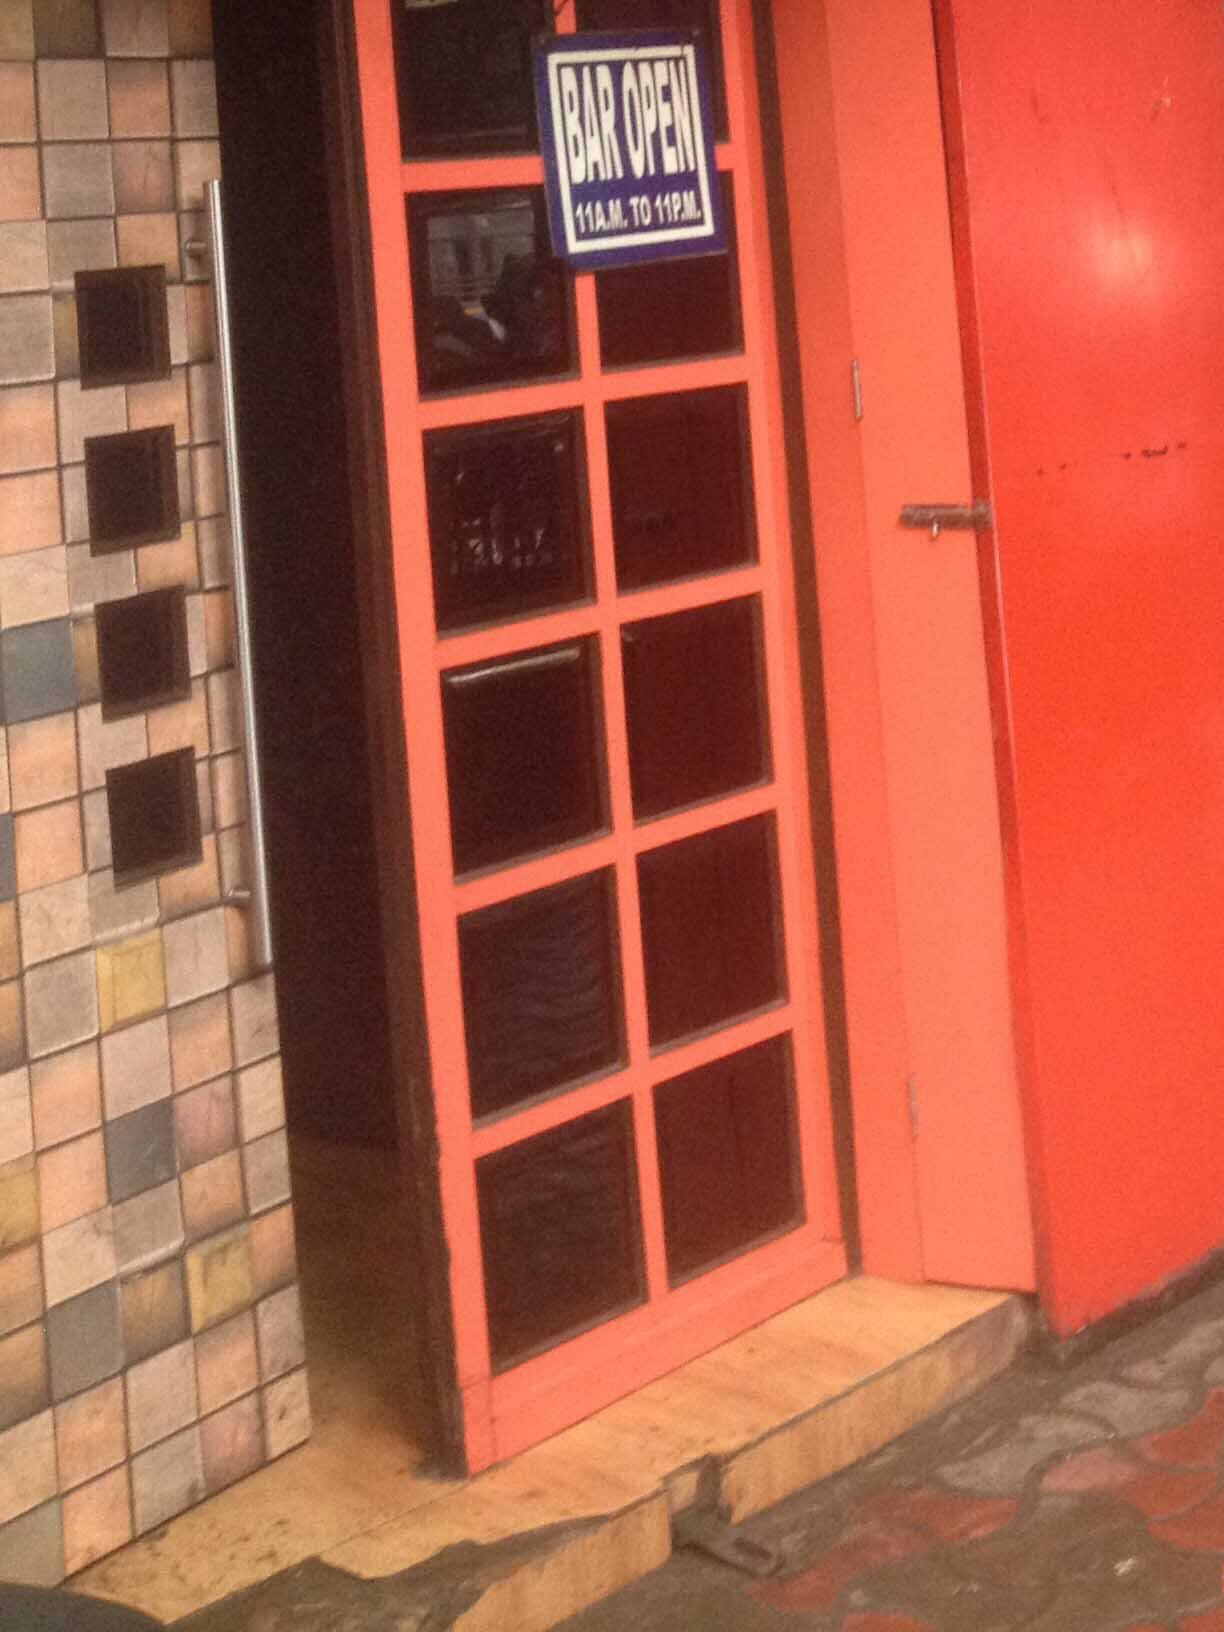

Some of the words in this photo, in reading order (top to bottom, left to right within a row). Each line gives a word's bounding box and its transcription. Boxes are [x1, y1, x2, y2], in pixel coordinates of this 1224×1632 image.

[560, 65, 623, 183] BAR
[622, 60, 696, 178] OPEN
[630, 194, 652, 227] TO
